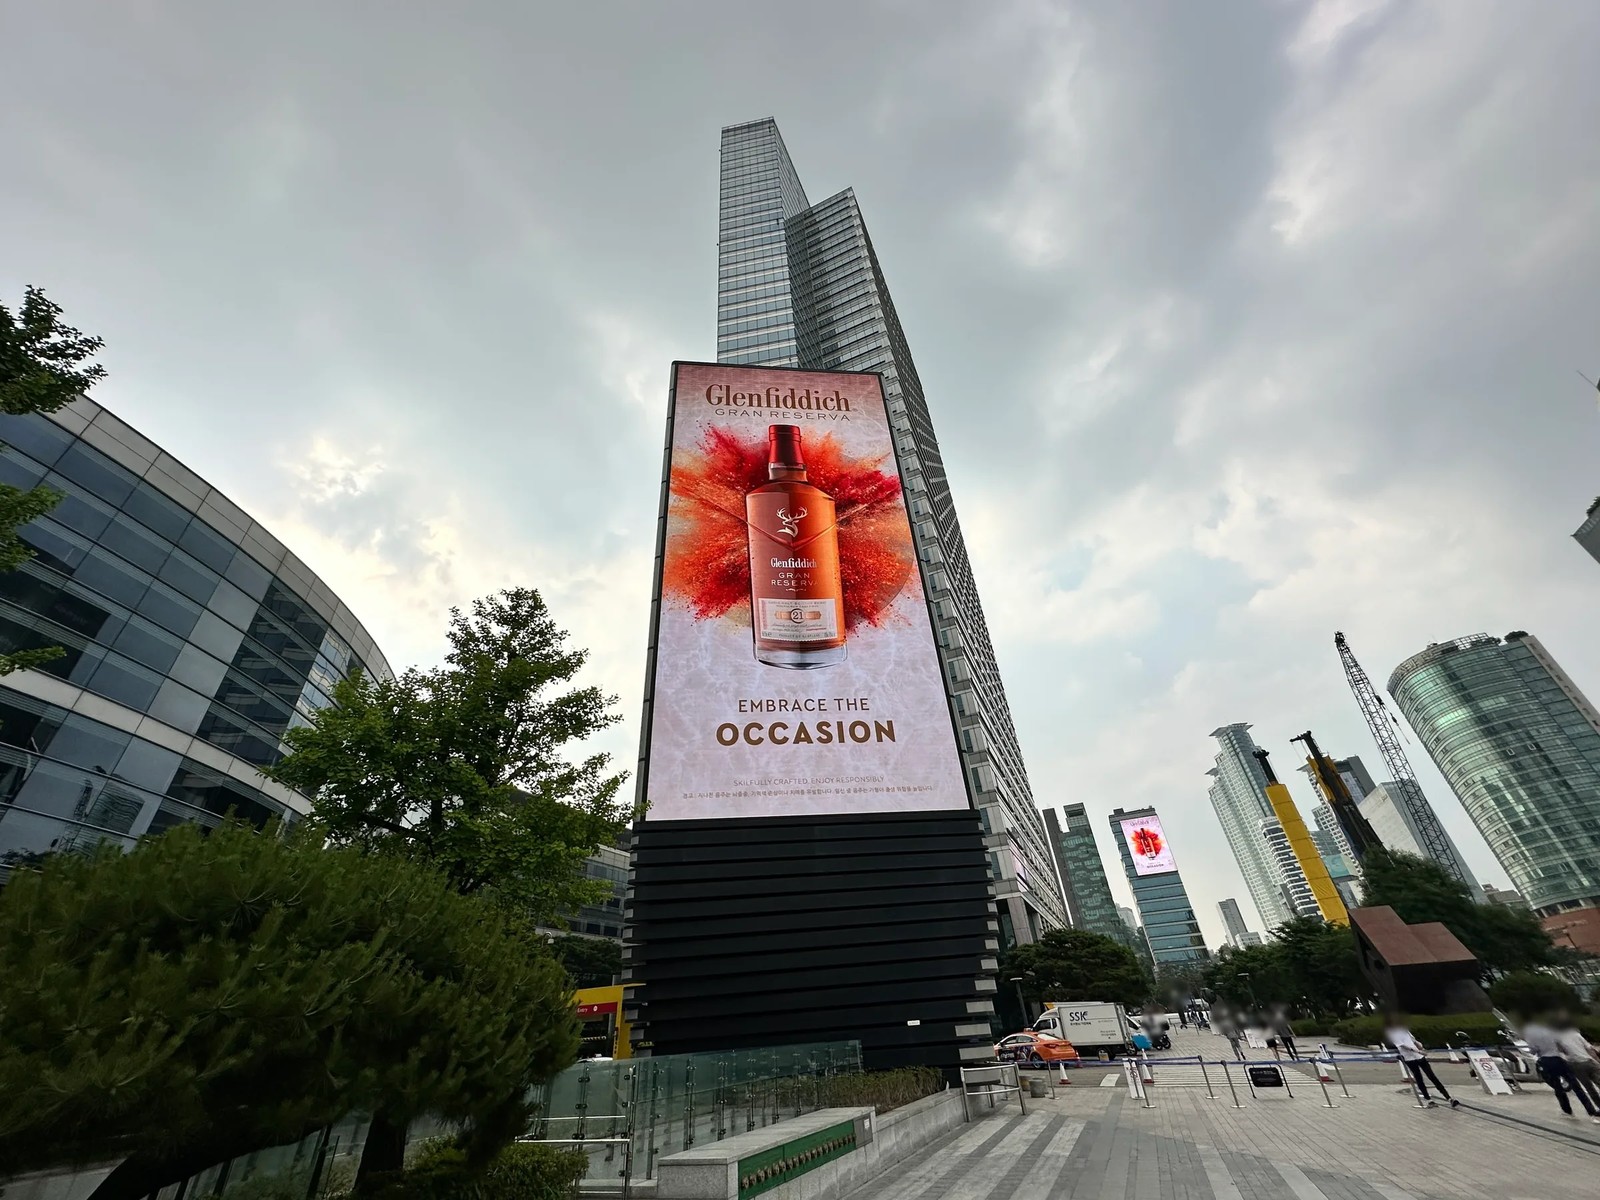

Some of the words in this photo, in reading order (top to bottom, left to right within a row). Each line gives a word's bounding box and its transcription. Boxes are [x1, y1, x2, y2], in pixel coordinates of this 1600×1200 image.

[706, 383, 850, 412] Glenfiddich
[715, 408, 762, 418] GRAN
[770, 411, 850, 421] RESERVA
[770, 557, 817, 568] Glenfiddich
[792, 611, 804, 620] 21
[738, 698, 828, 713] EMBRACE
[834, 698, 870, 711] THE
[716, 720, 896, 746] OCCASION
[733, 778, 772, 787] SKILFULLY
[811, 777, 835, 785] ENJOY
